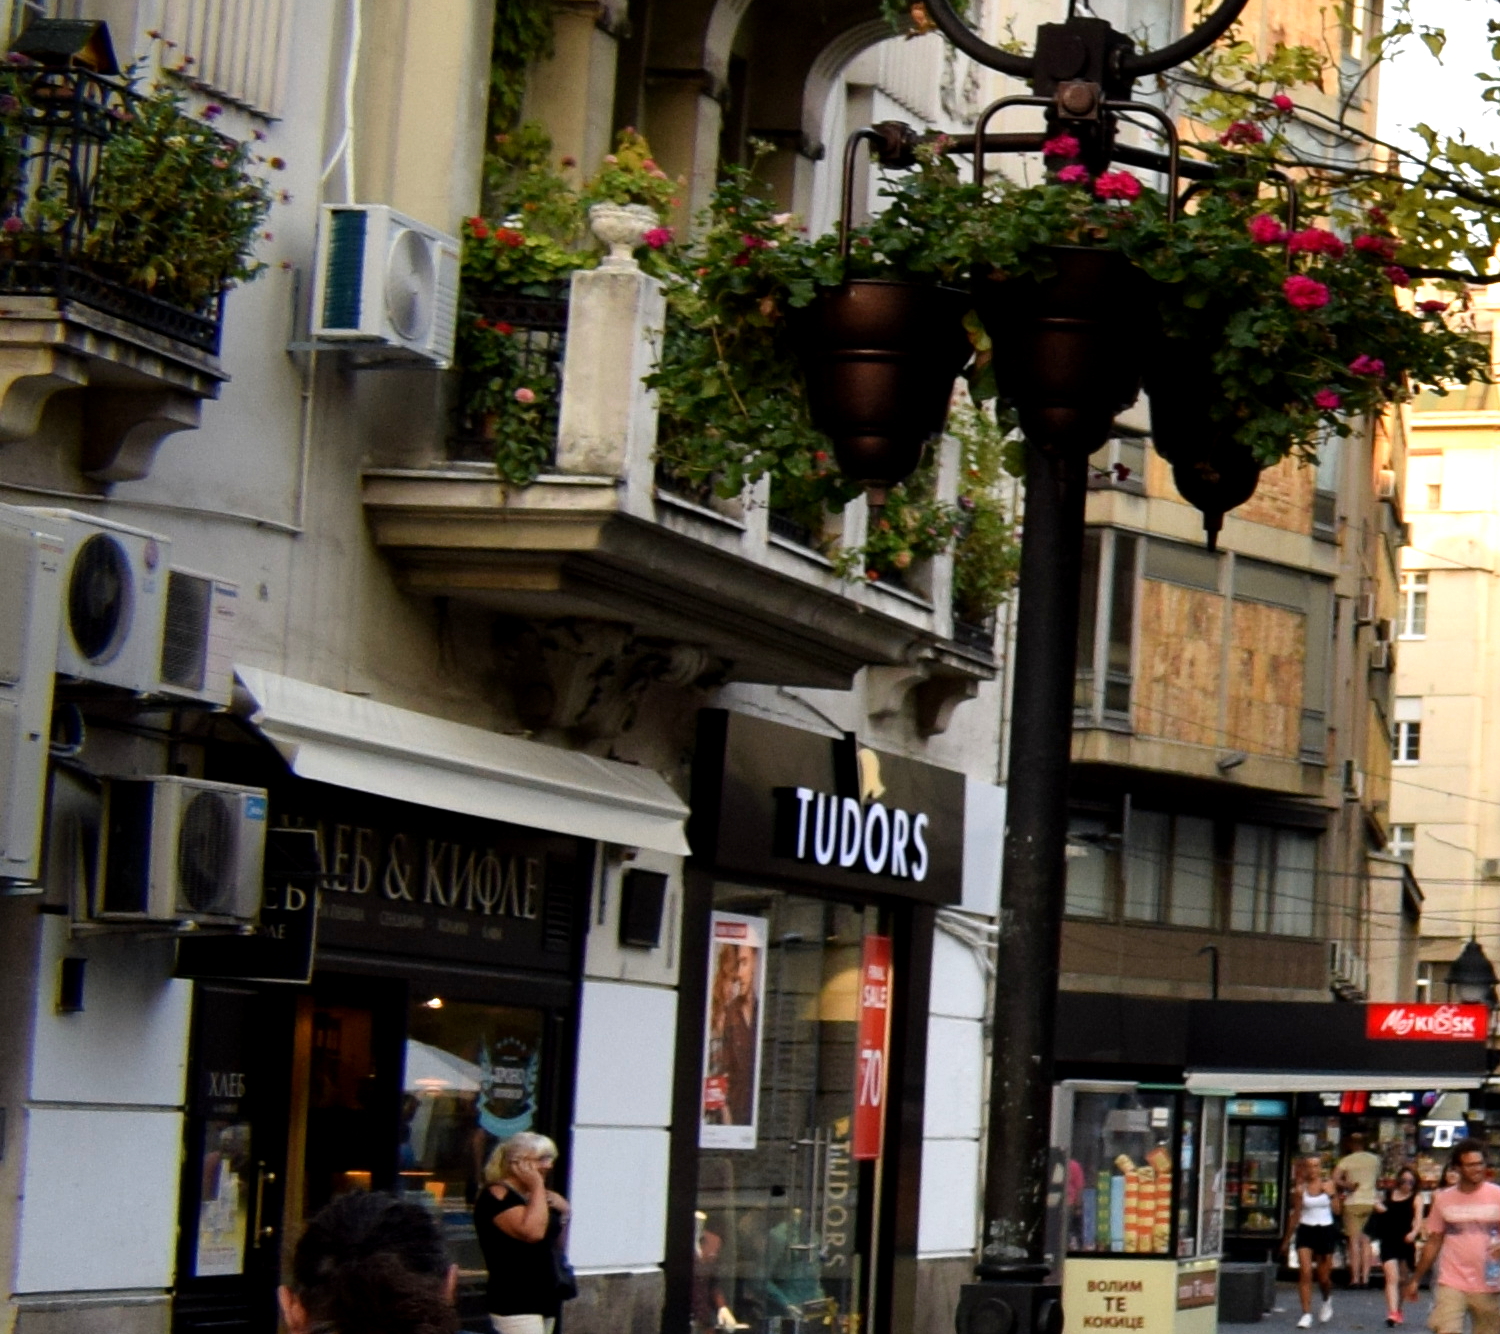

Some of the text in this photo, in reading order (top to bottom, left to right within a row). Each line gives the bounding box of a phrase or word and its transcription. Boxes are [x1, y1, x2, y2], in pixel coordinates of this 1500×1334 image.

[796, 787, 930, 882] TUDORS
[424, 837, 538, 920] КИФЛЕ
[863, 985, 888, 1008] SALE
[207, 1071, 246, 1098] ХЛЕБ
[1087, 1280, 1143, 1292] ВОЛИМ
[1104, 1297, 1127, 1312] ТЕ
[1083, 1317, 1144, 1331] КОКИЦЕ
